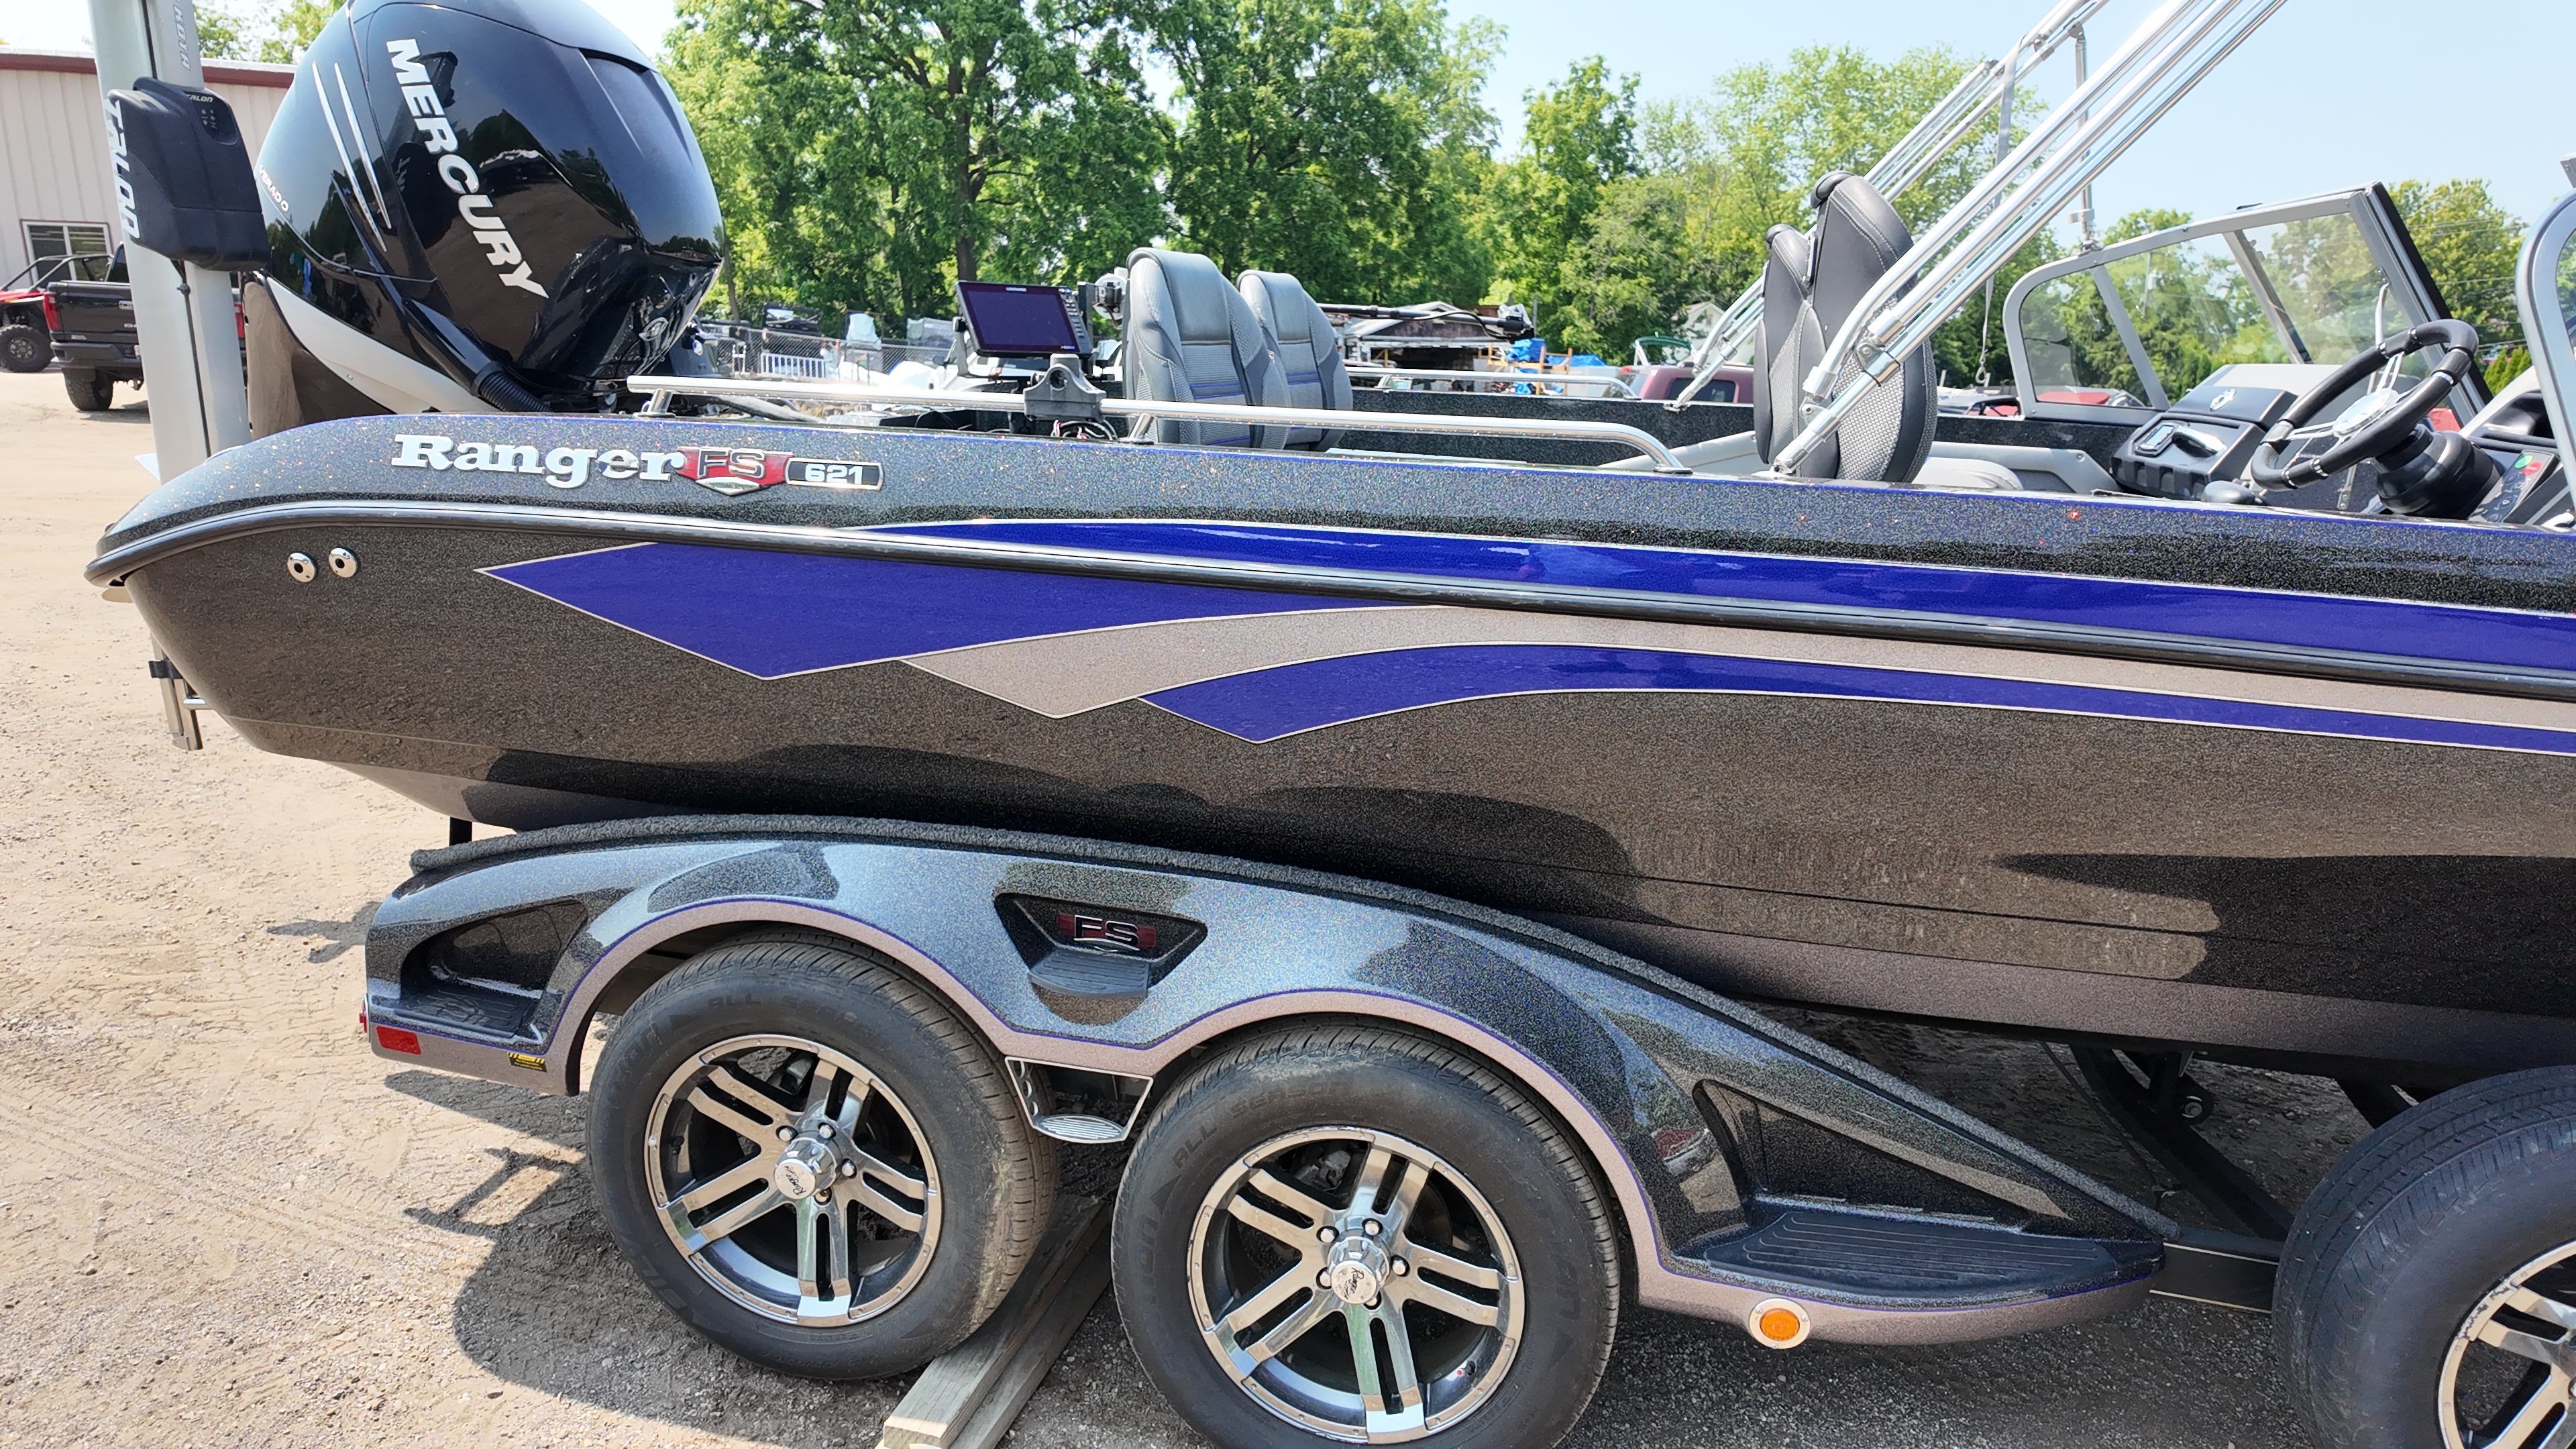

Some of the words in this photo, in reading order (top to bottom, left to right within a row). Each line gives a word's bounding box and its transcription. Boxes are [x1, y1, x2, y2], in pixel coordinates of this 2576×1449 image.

[172, 3, 191, 72] KOTA
[103, 99, 140, 239] TALON
[259, 164, 289, 212] VERADO
[386, 38, 549, 299] MERCURY
[391, 433, 687, 489] Ranger
[697, 446, 766, 479] FS
[805, 463, 863, 486] 621
[1073, 914, 1140, 948] FS
[1173, 1122, 1218, 1169] ALL
